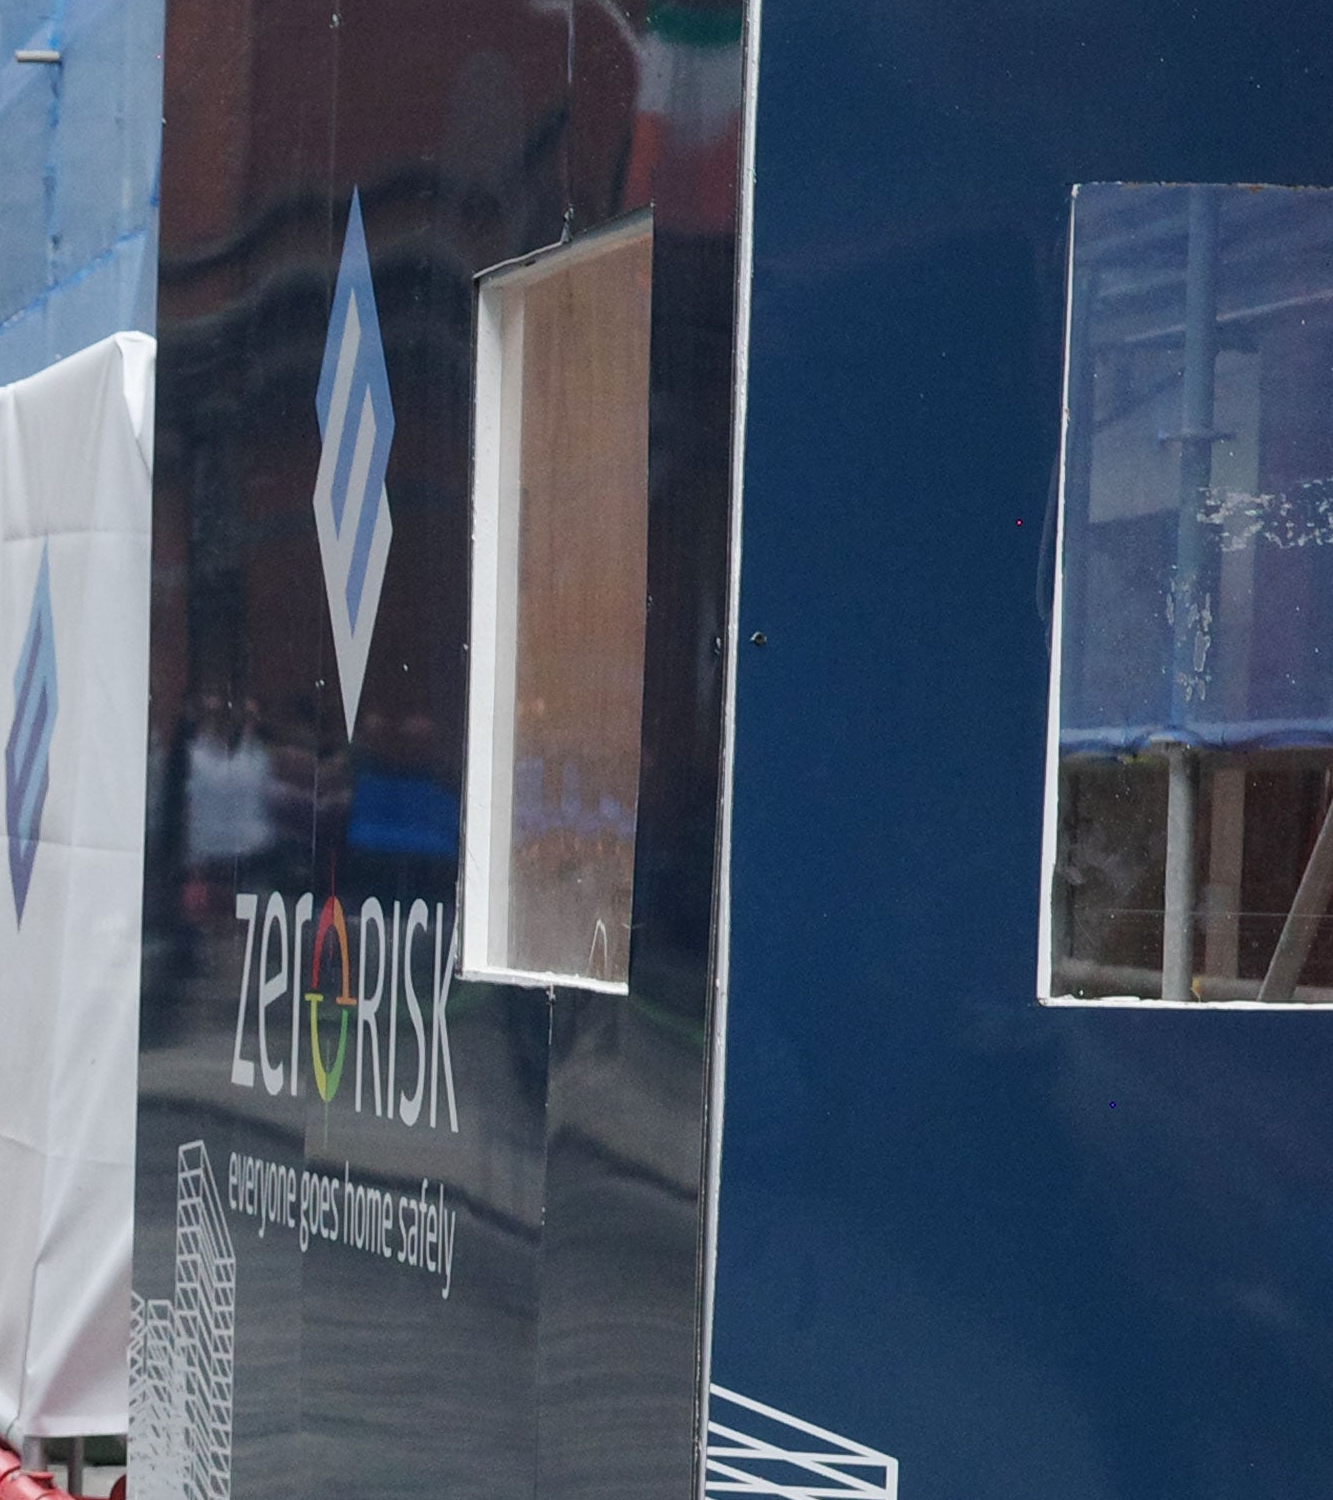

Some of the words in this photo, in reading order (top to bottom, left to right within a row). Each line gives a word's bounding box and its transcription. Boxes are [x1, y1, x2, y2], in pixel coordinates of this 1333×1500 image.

[228, 1151, 297, 1239] everyone
[299, 1170, 340, 1253] goes
[343, 1160, 394, 1258] home
[397, 1177, 456, 1300] safely
